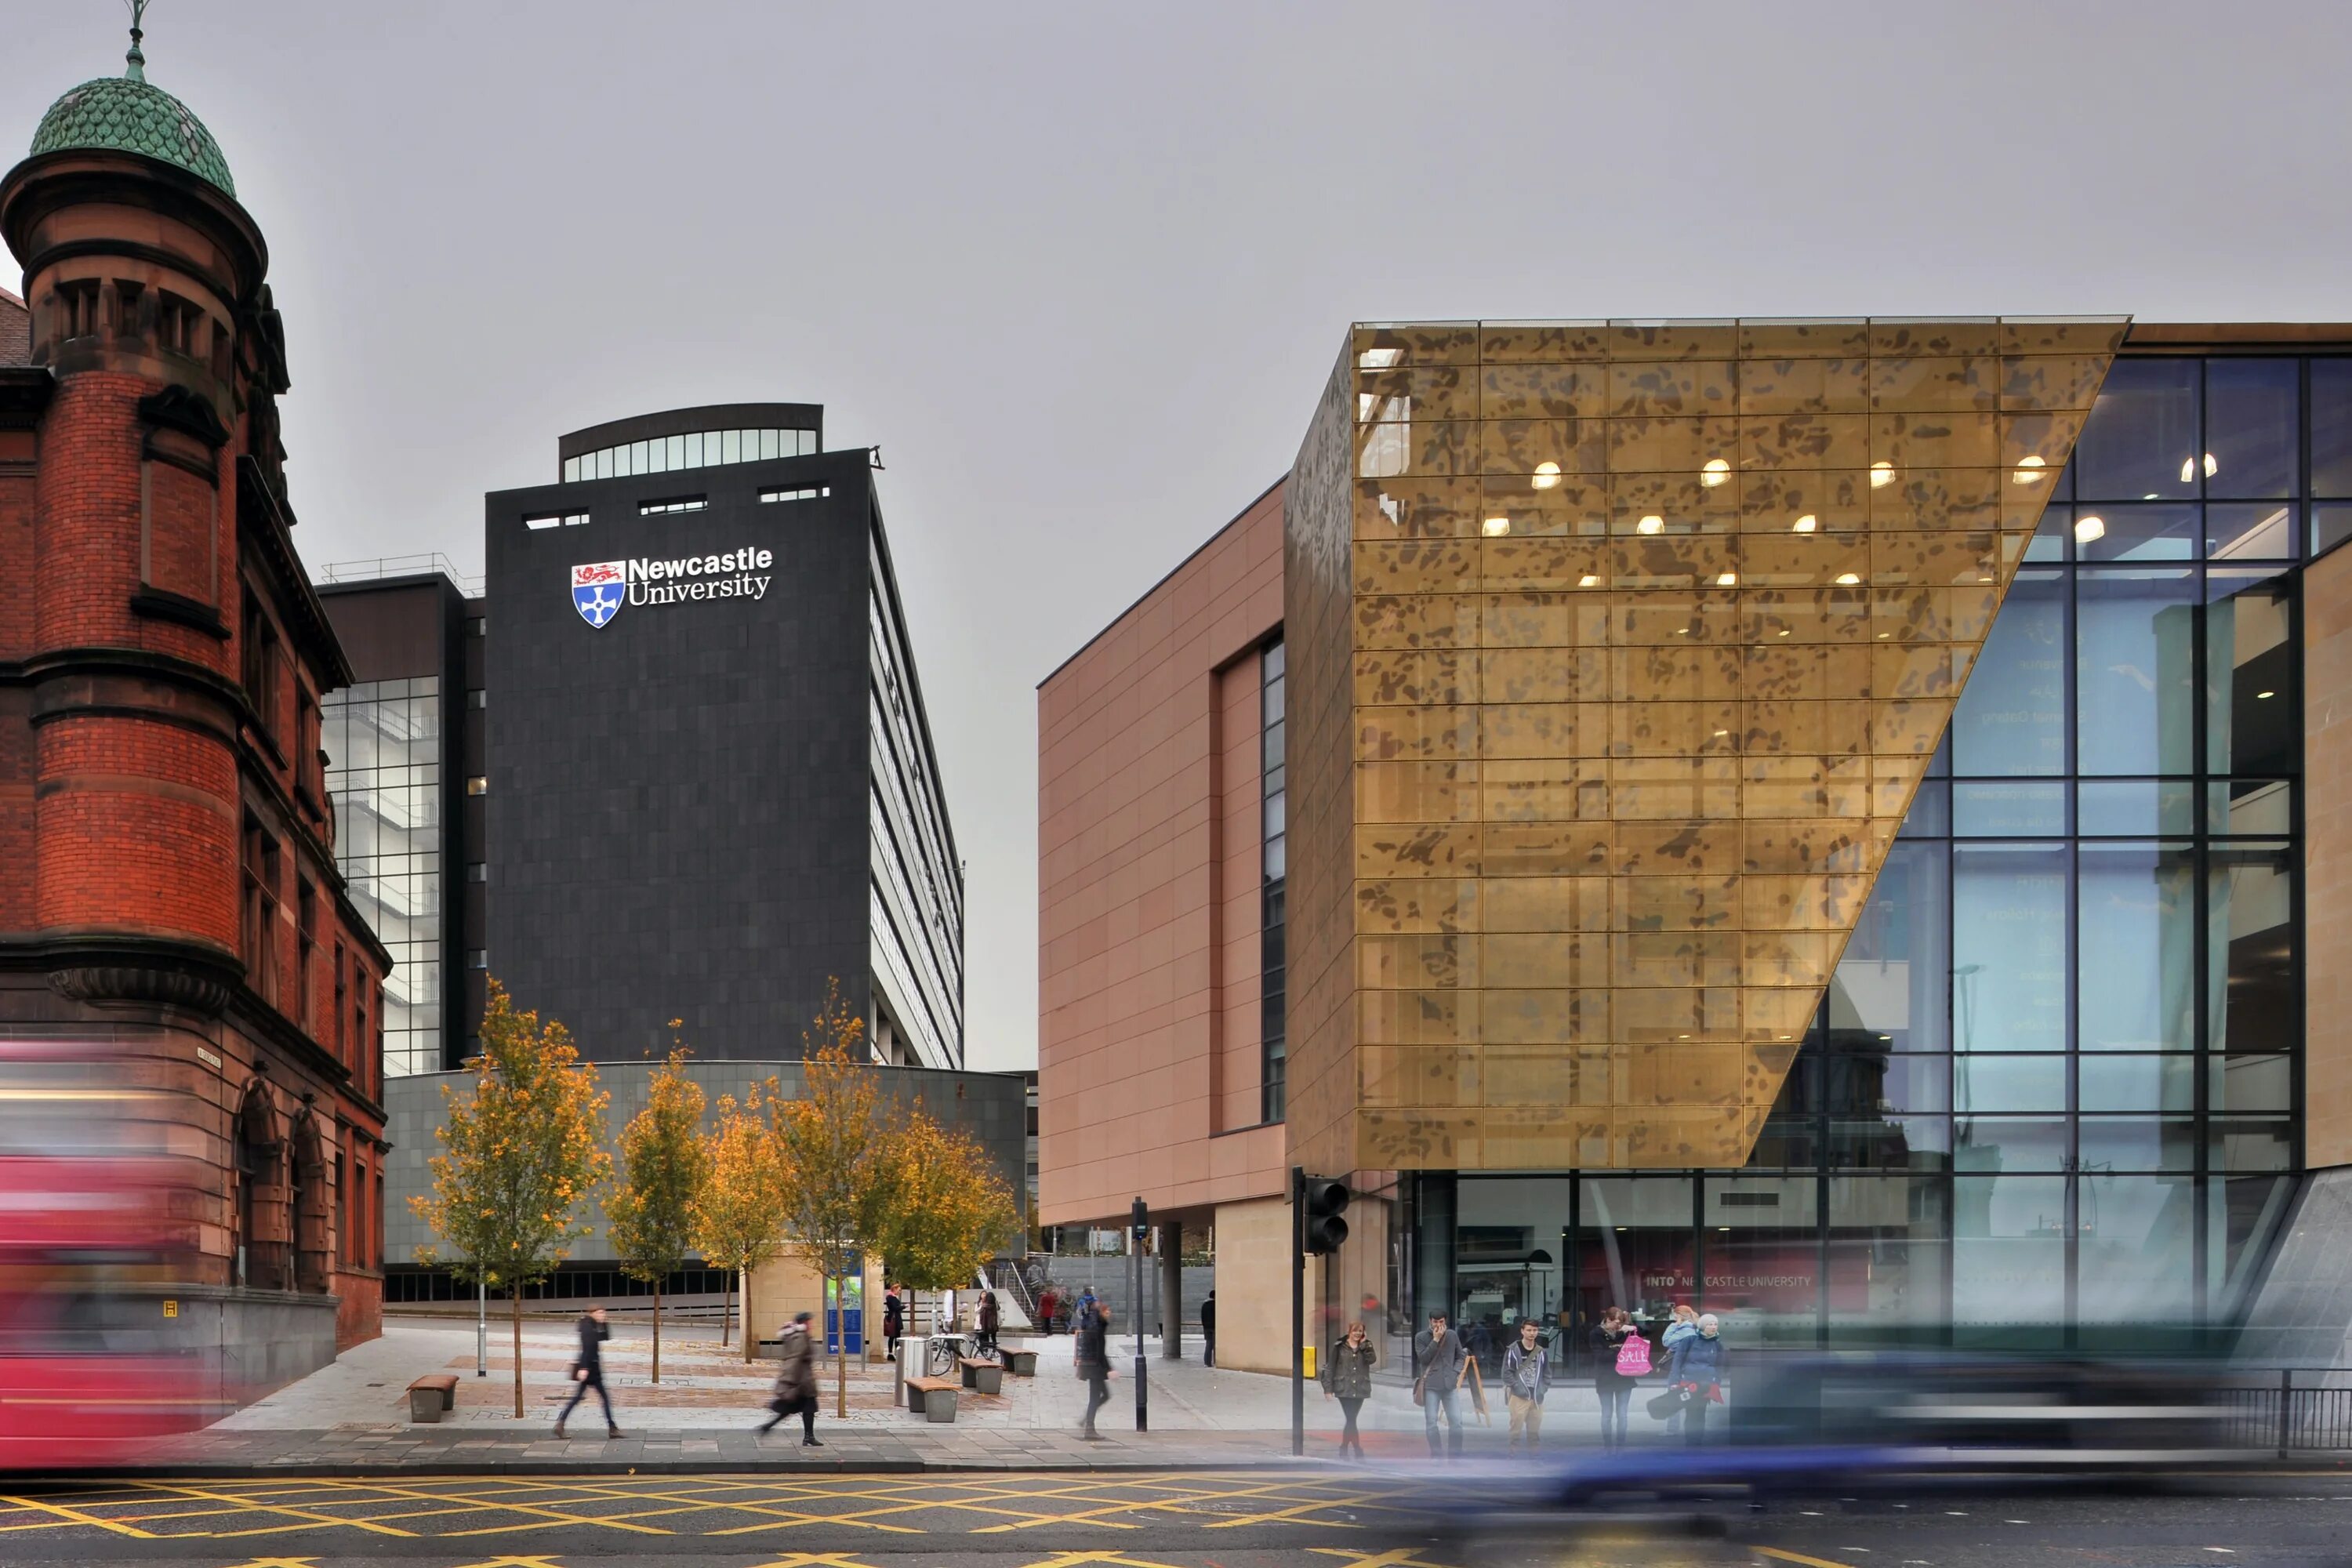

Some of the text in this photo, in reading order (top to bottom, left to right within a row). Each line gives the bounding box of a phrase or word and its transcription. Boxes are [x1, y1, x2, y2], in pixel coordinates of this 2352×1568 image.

[629, 546, 772, 582] Newcastle
[626, 572, 771, 606] University
[1646, 1276, 1811, 1287] INTO NECASTLE UNIVERSITY
[1617, 1349, 1648, 1363] SALE
